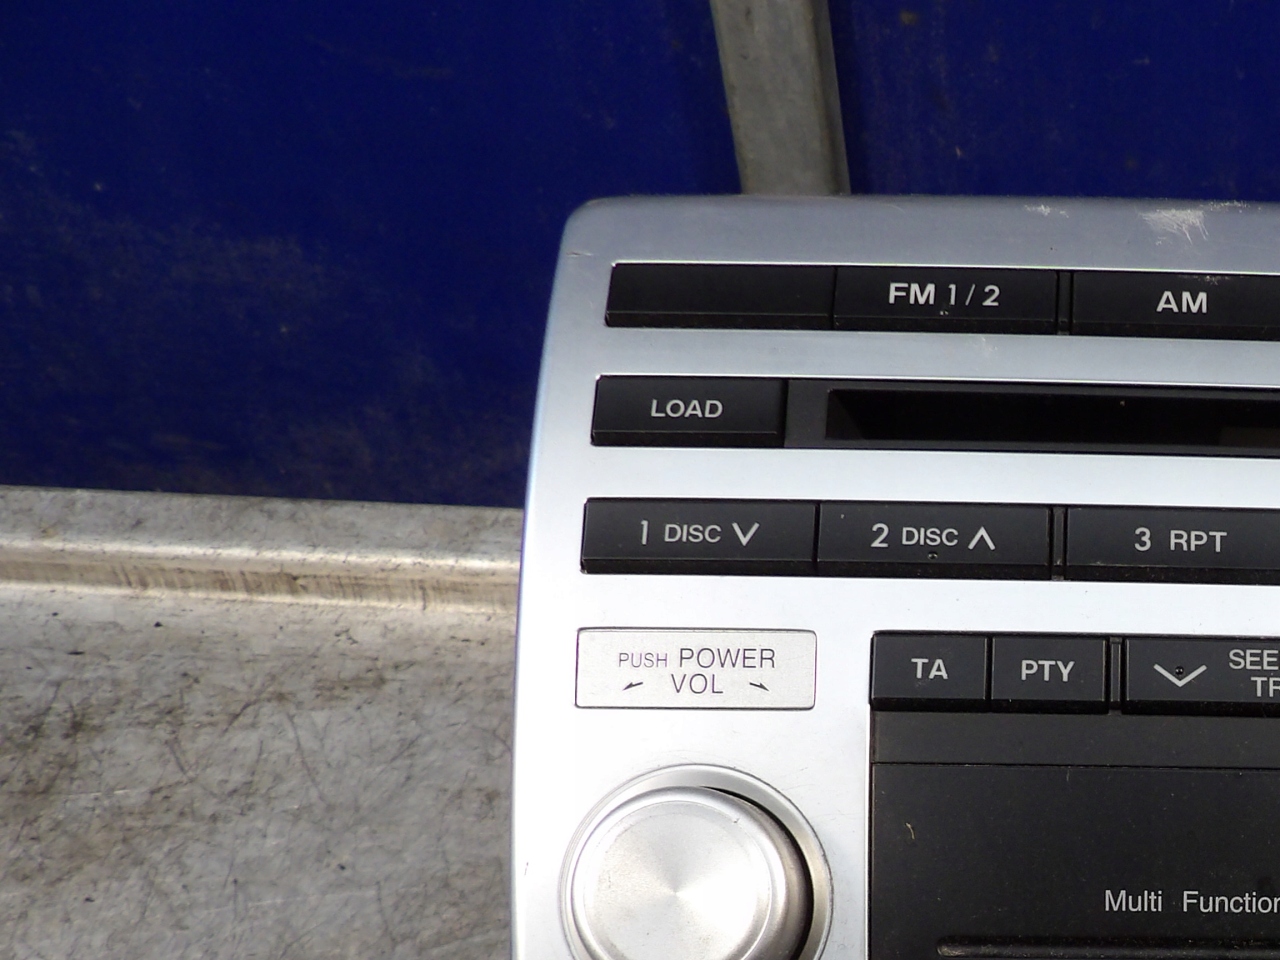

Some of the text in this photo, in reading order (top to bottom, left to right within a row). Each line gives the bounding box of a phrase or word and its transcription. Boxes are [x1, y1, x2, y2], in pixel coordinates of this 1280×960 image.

[888, 281, 936, 305] FM
[1156, 290, 1207, 314] AM
[650, 399, 723, 418] LOAD
[640, 519, 722, 545] 1 DISC
[870, 522, 959, 548] 2 DISC
[1134, 527, 1228, 553] 3 RPT
[618, 648, 775, 669] PUSH POWER
[910, 658, 948, 680] TA
[1021, 659, 1075, 682] PTY
[671, 673, 723, 694] VOL
[1105, 889, 1162, 912] Multi
